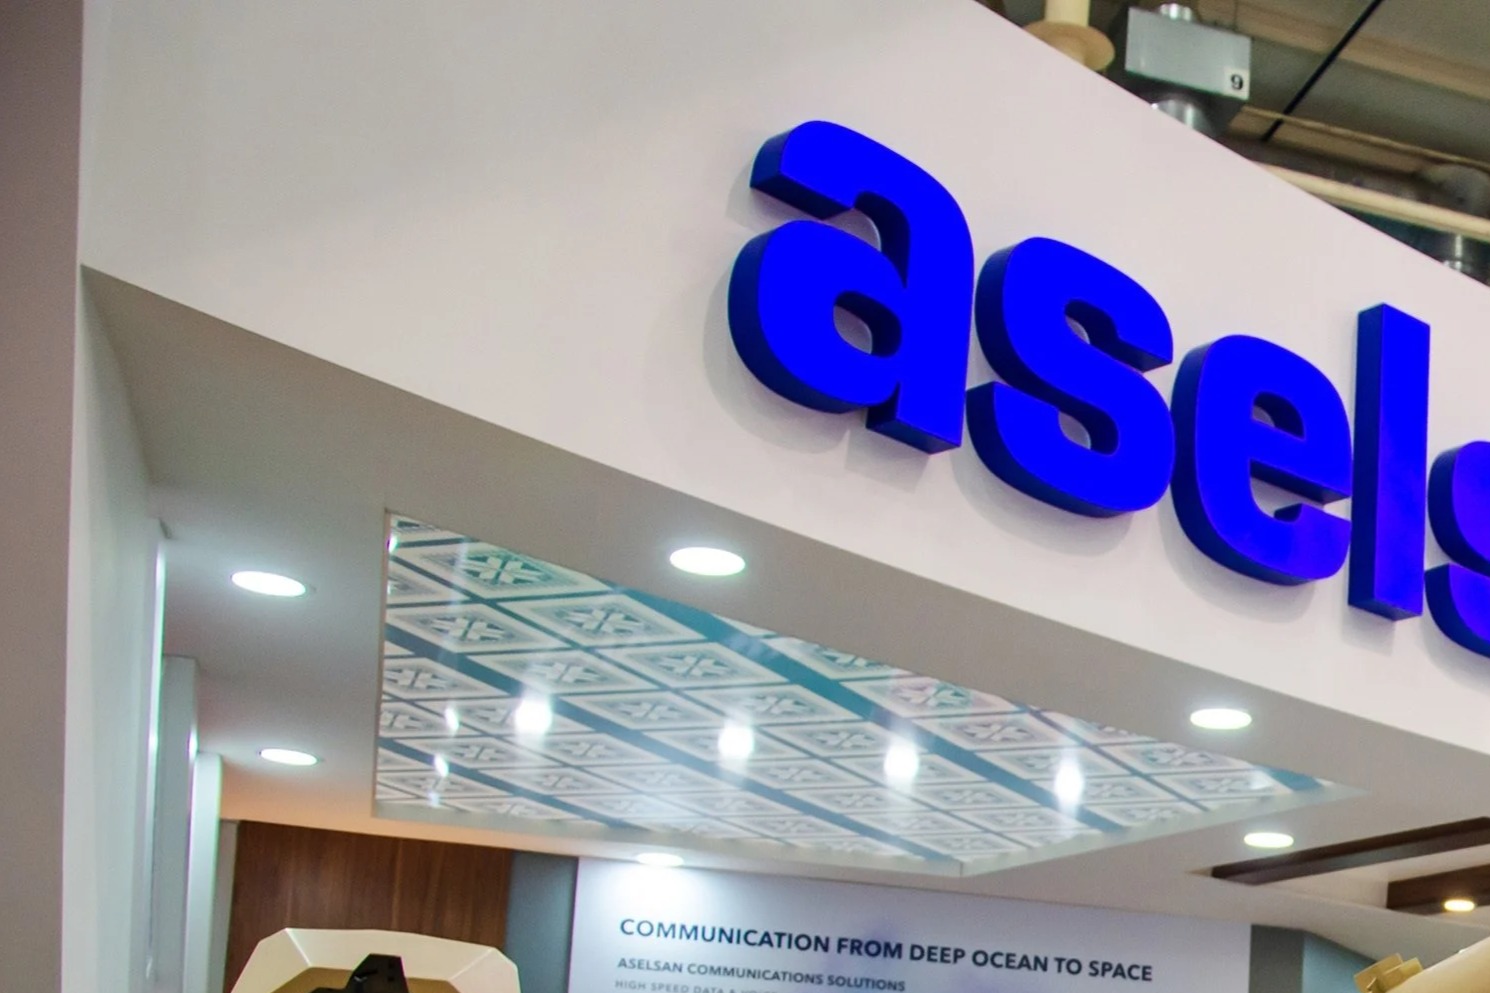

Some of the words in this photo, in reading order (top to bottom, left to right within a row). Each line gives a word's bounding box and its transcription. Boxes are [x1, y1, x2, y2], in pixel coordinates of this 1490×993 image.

[1230, 74, 1244, 90] 9
[620, 918, 829, 953] COMMUNICATION
[836, 937, 903, 960] FROM
[909, 943, 966, 965] DEEP
[971, 950, 1048, 972] OCEAN
[1054, 957, 1083, 975] TO
[1088, 960, 1153, 981] SPACE
[615, 979, 646, 991] HIGH
[617, 957, 683, 973] ASELSAN
[687, 963, 823, 986] COMMUNICATIONS
[827, 974, 906, 992] SOLUTIONS
